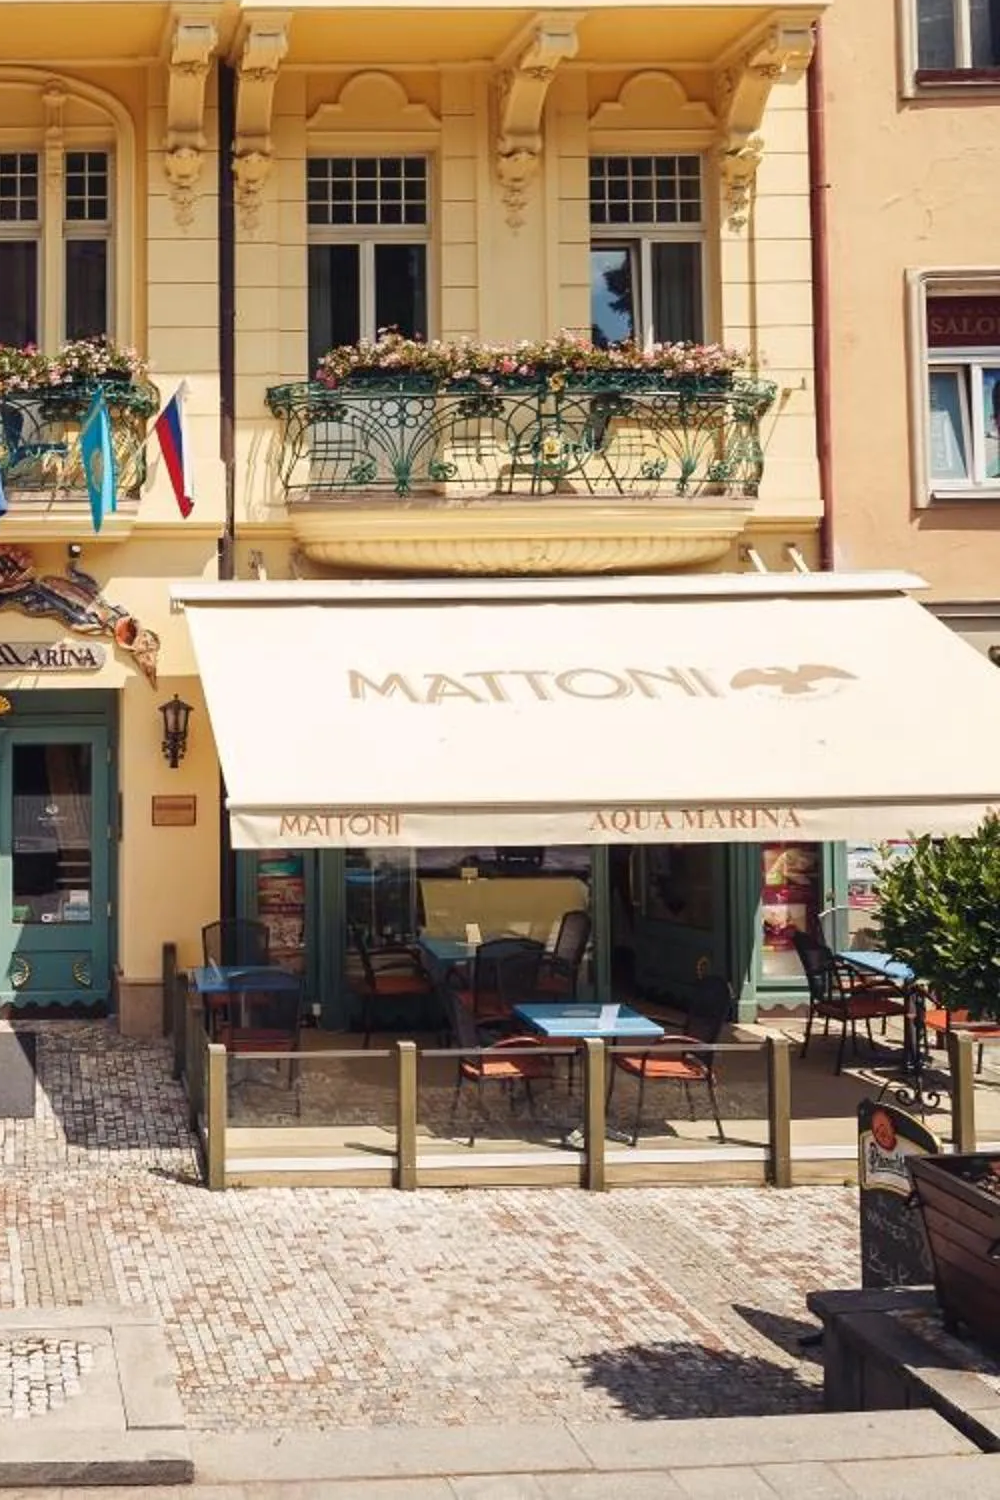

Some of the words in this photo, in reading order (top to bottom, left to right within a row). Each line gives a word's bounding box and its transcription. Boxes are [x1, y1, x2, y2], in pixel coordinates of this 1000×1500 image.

[931, 315, 1000, 336] SALO
[347, 666, 722, 703] MATTONI
[280, 812, 400, 836] MATTONI
[589, 808, 673, 834] AQUA
[680, 804, 801, 828] MARINA
